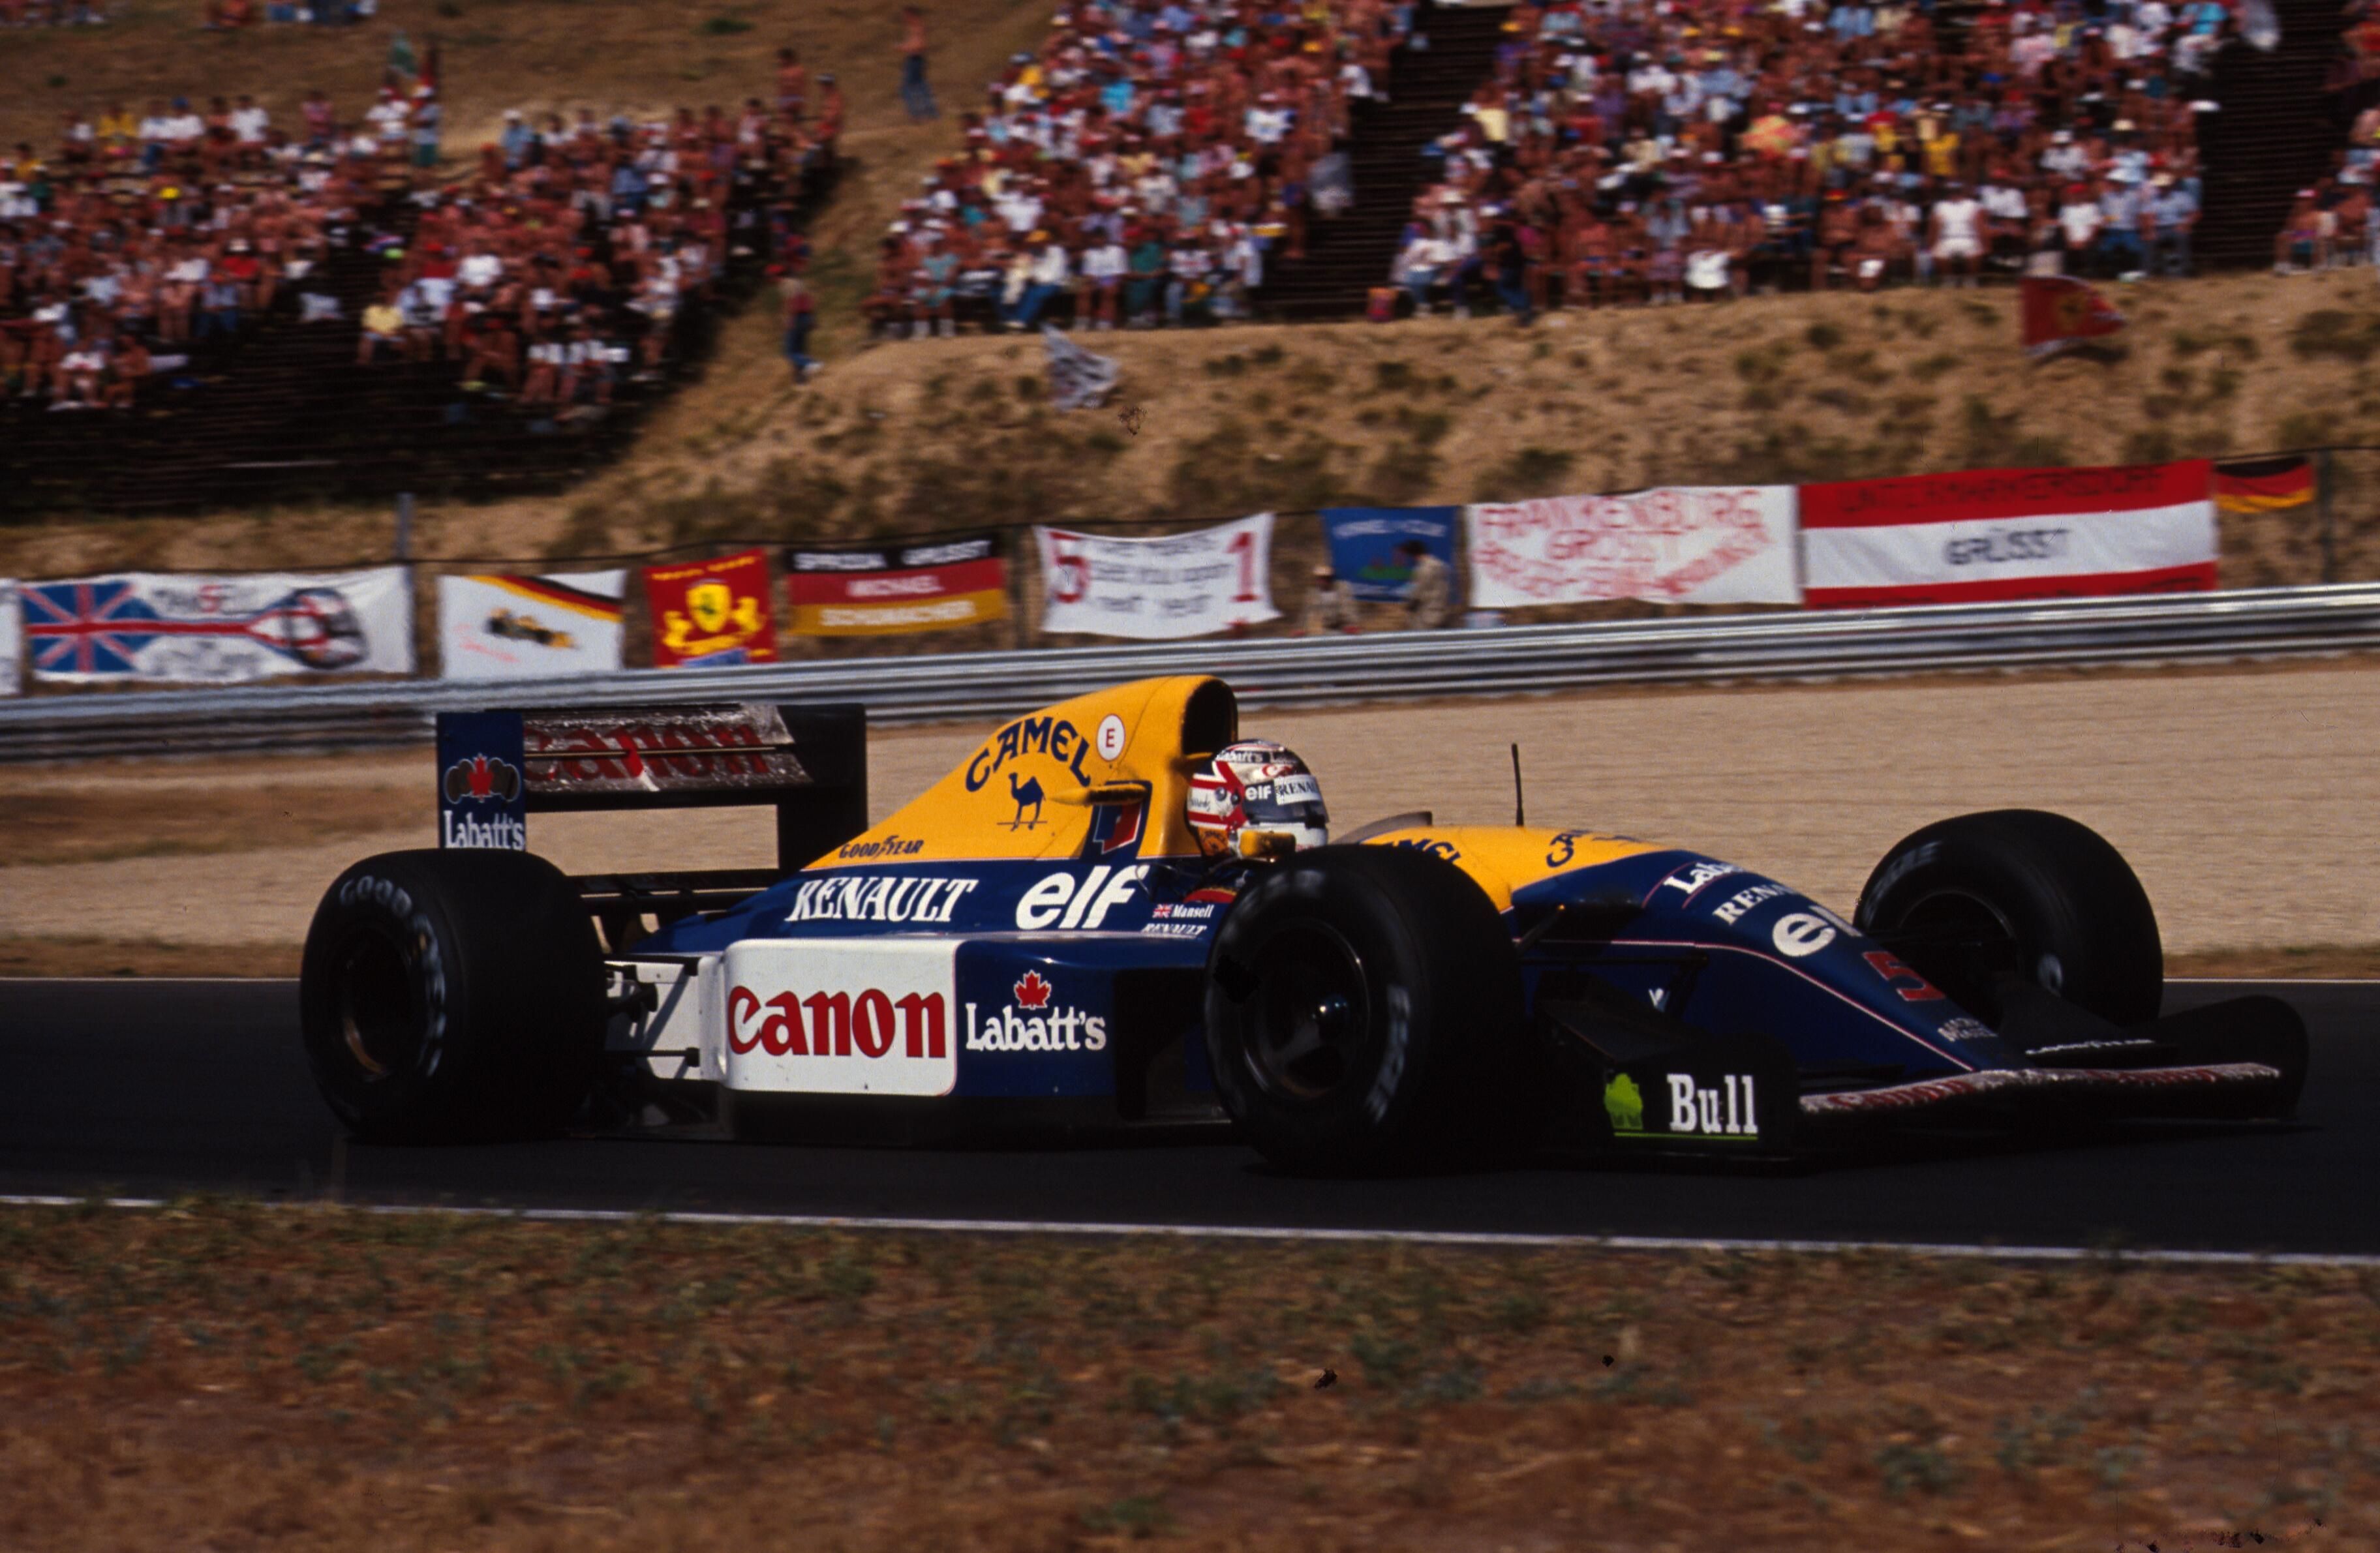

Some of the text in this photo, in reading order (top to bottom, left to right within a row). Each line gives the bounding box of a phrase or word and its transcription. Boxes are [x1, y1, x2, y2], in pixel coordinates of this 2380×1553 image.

[1049, 531, 1090, 603] 5
[1226, 532, 1260, 603] 1
[966, 717, 1091, 792] CAMEL
[1105, 727, 1116, 747] E
[1245, 785, 1272, 802] elf
[443, 809, 526, 850] Labatt's
[785, 876, 978, 922] RENAULT
[1015, 864, 1150, 930] elf
[1170, 903, 1214, 919] Mansell
[1140, 922, 1208, 935] RENAULT
[1861, 950, 1946, 1002] 5
[728, 986, 947, 1058] Canon
[966, 1003, 1107, 1051] Labatt's
[1666, 1073, 1759, 1135] Bull
